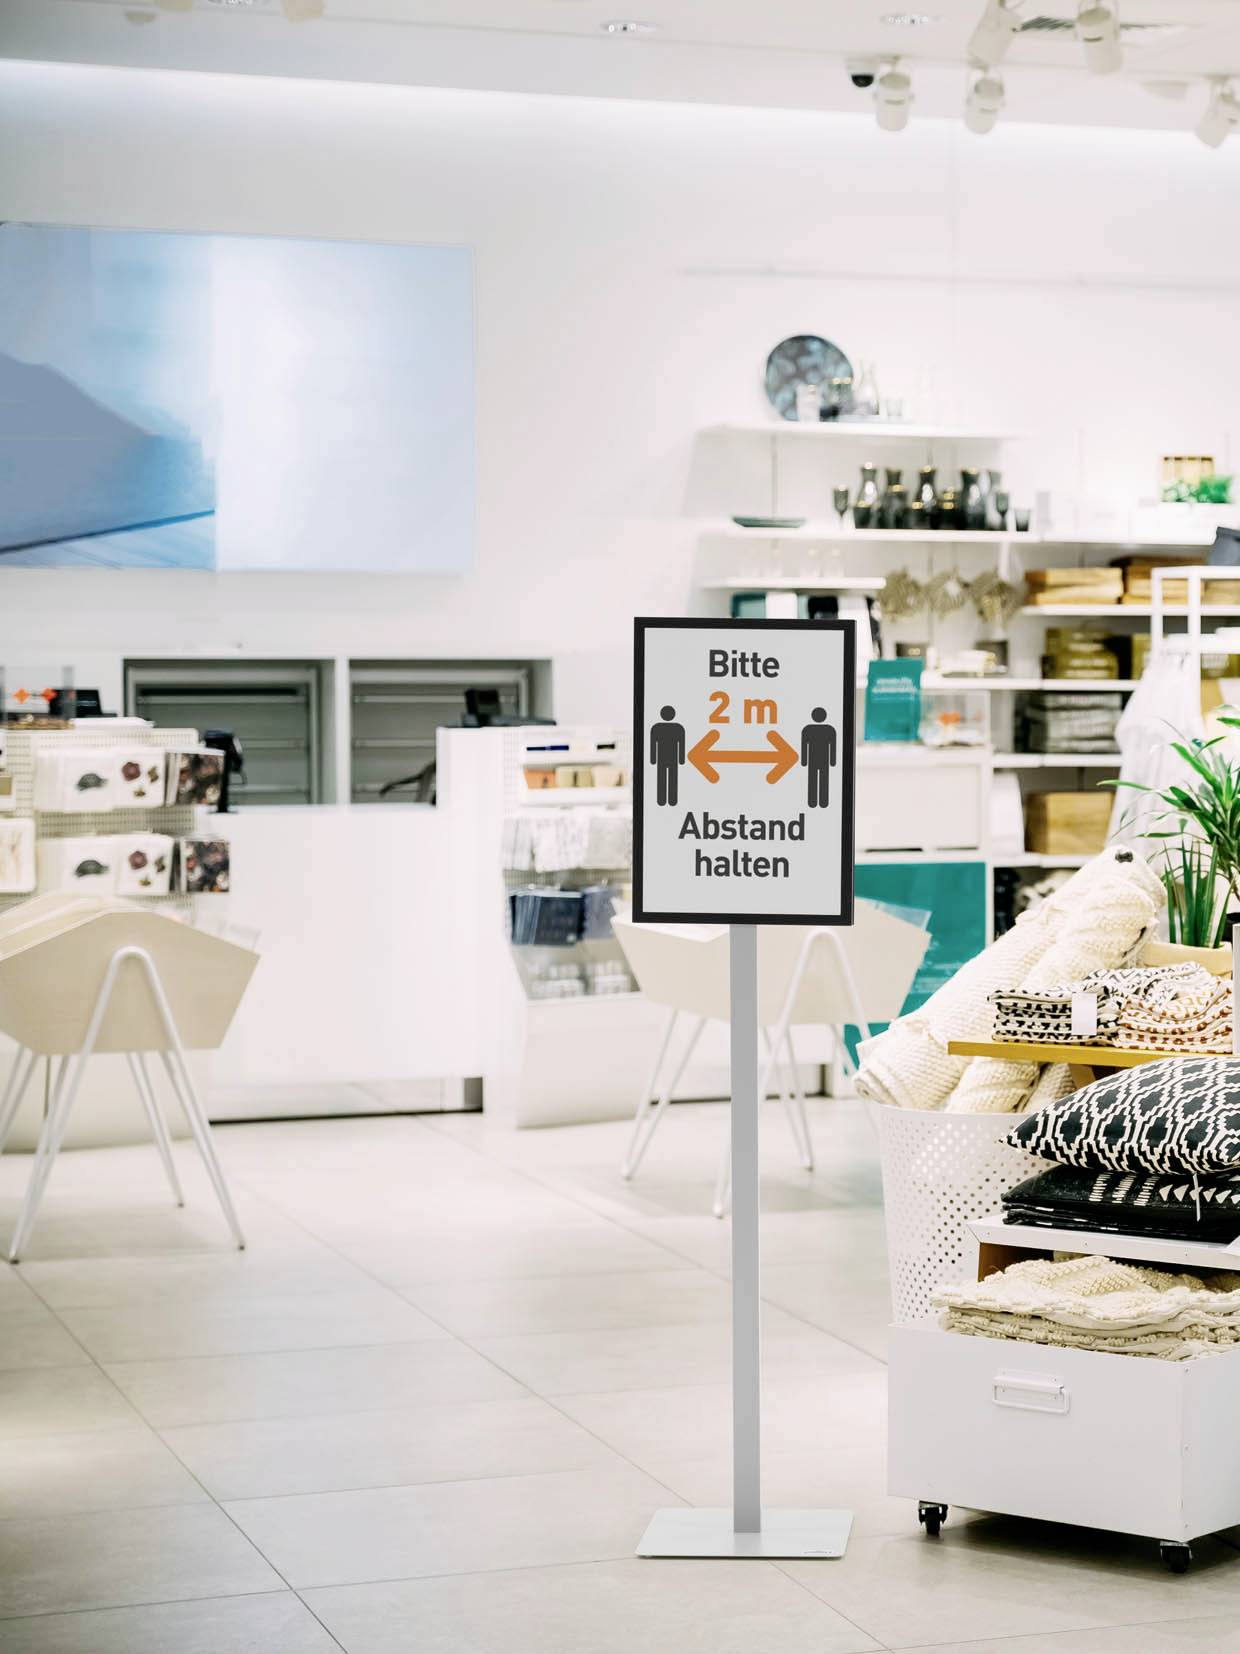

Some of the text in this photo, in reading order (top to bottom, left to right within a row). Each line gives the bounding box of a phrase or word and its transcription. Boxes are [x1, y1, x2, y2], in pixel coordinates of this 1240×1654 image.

[708, 649, 780, 678] Bitte
[708, 690, 778, 725] 2 m
[678, 811, 805, 841] Abstand
[695, 848, 790, 878] halten
